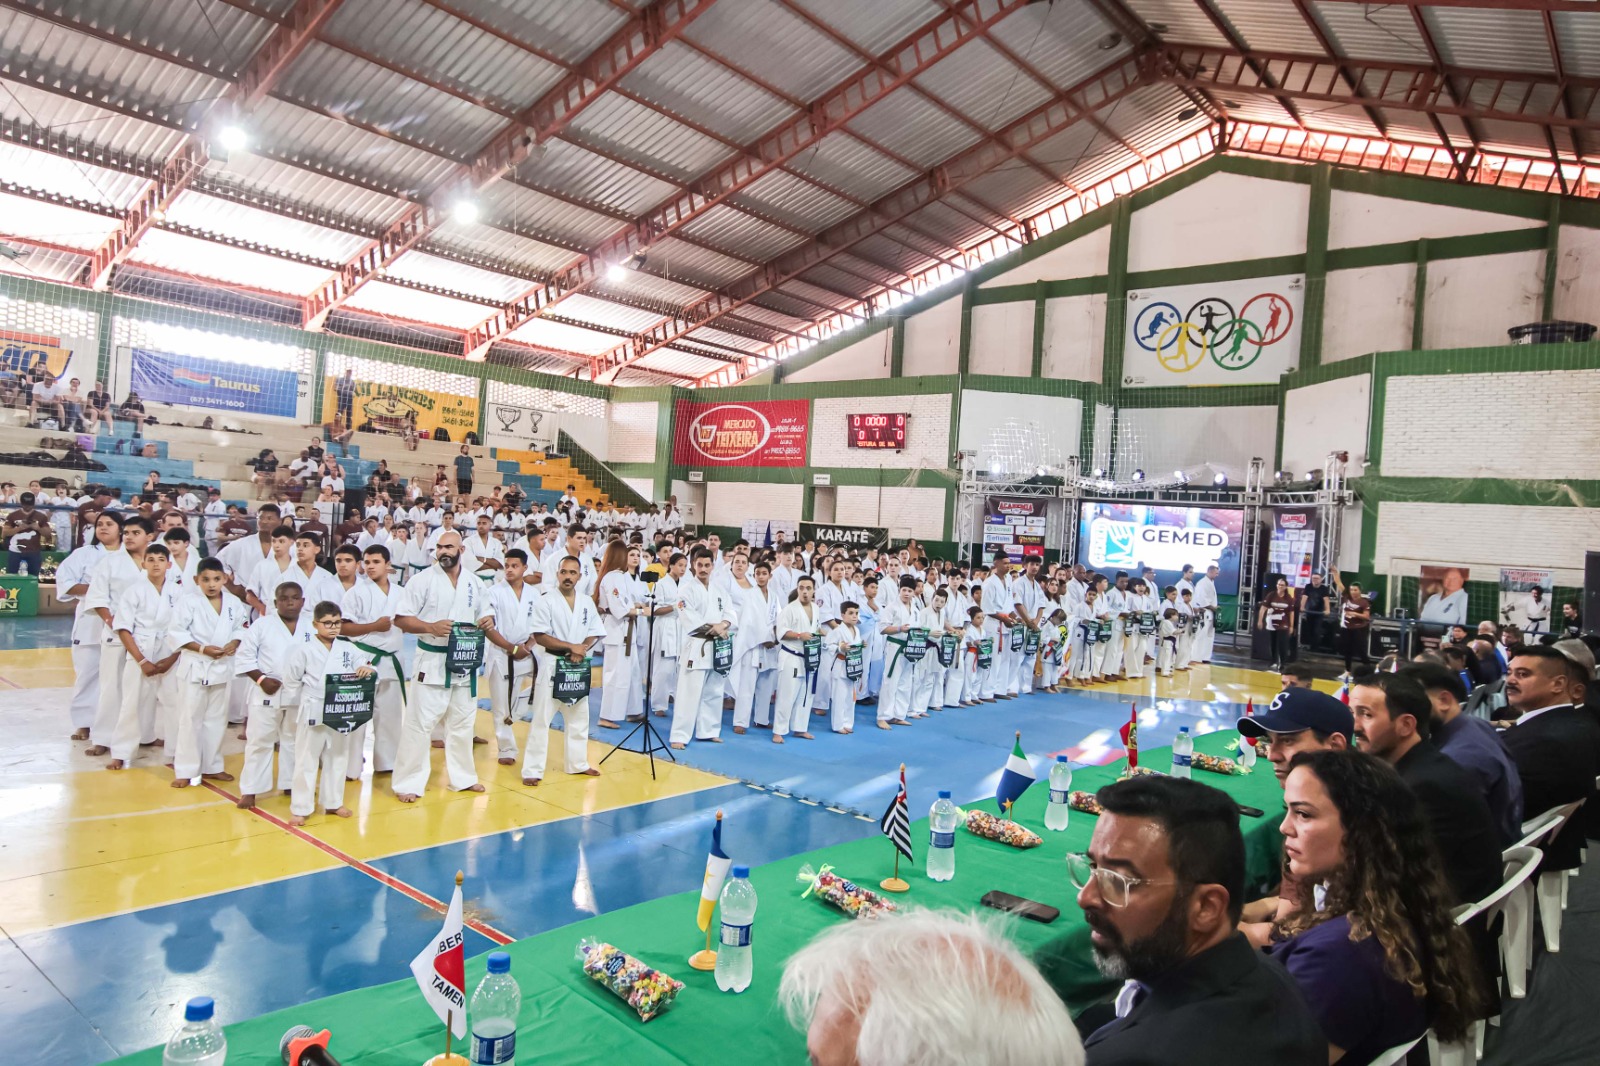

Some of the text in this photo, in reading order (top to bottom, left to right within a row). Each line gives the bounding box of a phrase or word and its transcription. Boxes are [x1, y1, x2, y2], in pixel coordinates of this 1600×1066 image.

[212, 376, 261, 393] Taurus
[206, 397, 245, 408] 3411-1600
[723, 419, 756, 429] MERCADO
[716, 430, 759, 448] TEIXEIRA
[815, 528, 869, 544] KARATÊ
[1142, 529, 1223, 547] GEMED
[456, 641, 477, 651] DAIDO
[453, 650, 478, 660] KARATÊ
[559, 682, 585, 692] KAKUSHI
[334, 690, 364, 703] ASSOCIAÇÃO
[325, 704, 345, 714] BALBOA
[346, 703, 352, 713] DE
[431, 974, 465, 1009] TAMEN
